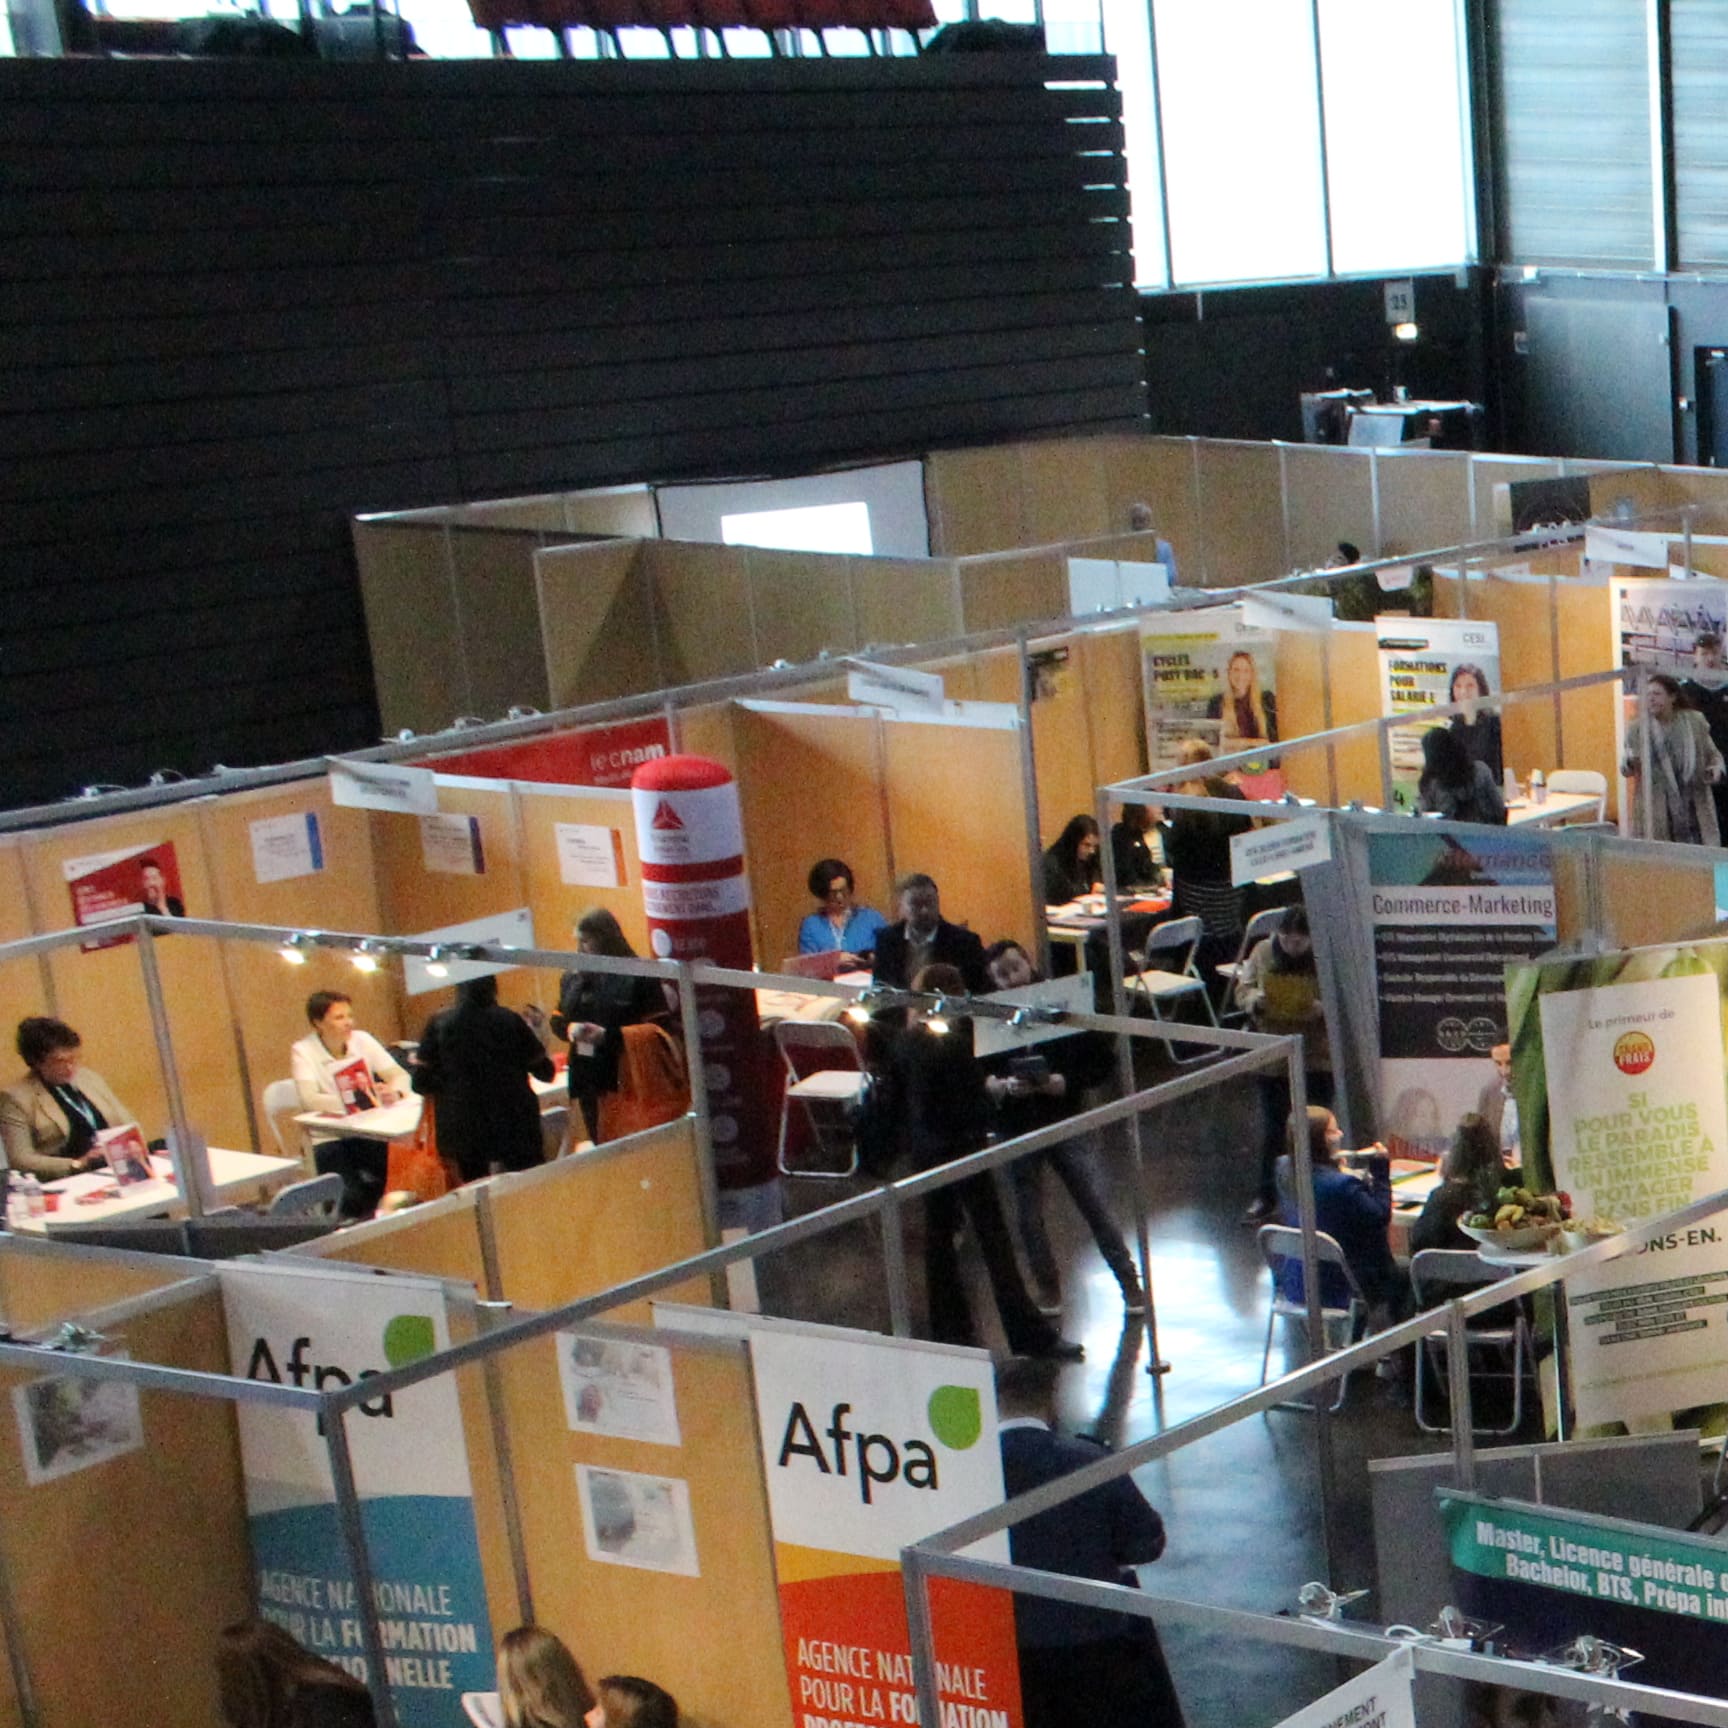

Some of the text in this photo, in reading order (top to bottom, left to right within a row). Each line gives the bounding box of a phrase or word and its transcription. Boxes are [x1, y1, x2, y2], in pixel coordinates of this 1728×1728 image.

[1371, 893, 1554, 918] Commerce-Marketing
[1618, 1051, 1651, 1066] FRAIS
[1573, 1102, 1698, 1136] POUR VOUS
[1576, 1119, 1700, 1153] LE PARADIS
[1567, 1143, 1694, 1175] RESSEMBLE
[1572, 1154, 1711, 1192] UN IMMENSE
[1593, 1175, 1693, 1207] POTAGER
[777, 1400, 940, 1505] Afpa
[1476, 1521, 1545, 1559] Master,
[1549, 1534, 1624, 1572] Licence
[1628, 1550, 1716, 1591] générale
[1505, 1553, 1593, 1596] Bachelor,
[1597, 1572, 1640, 1607] BTS,
[1643, 1579, 1701, 1618] Prépa
[309, 1620, 338, 1647] LA
[796, 1637, 873, 1680] AGENCE
[800, 1674, 885, 1720] POUR LA
